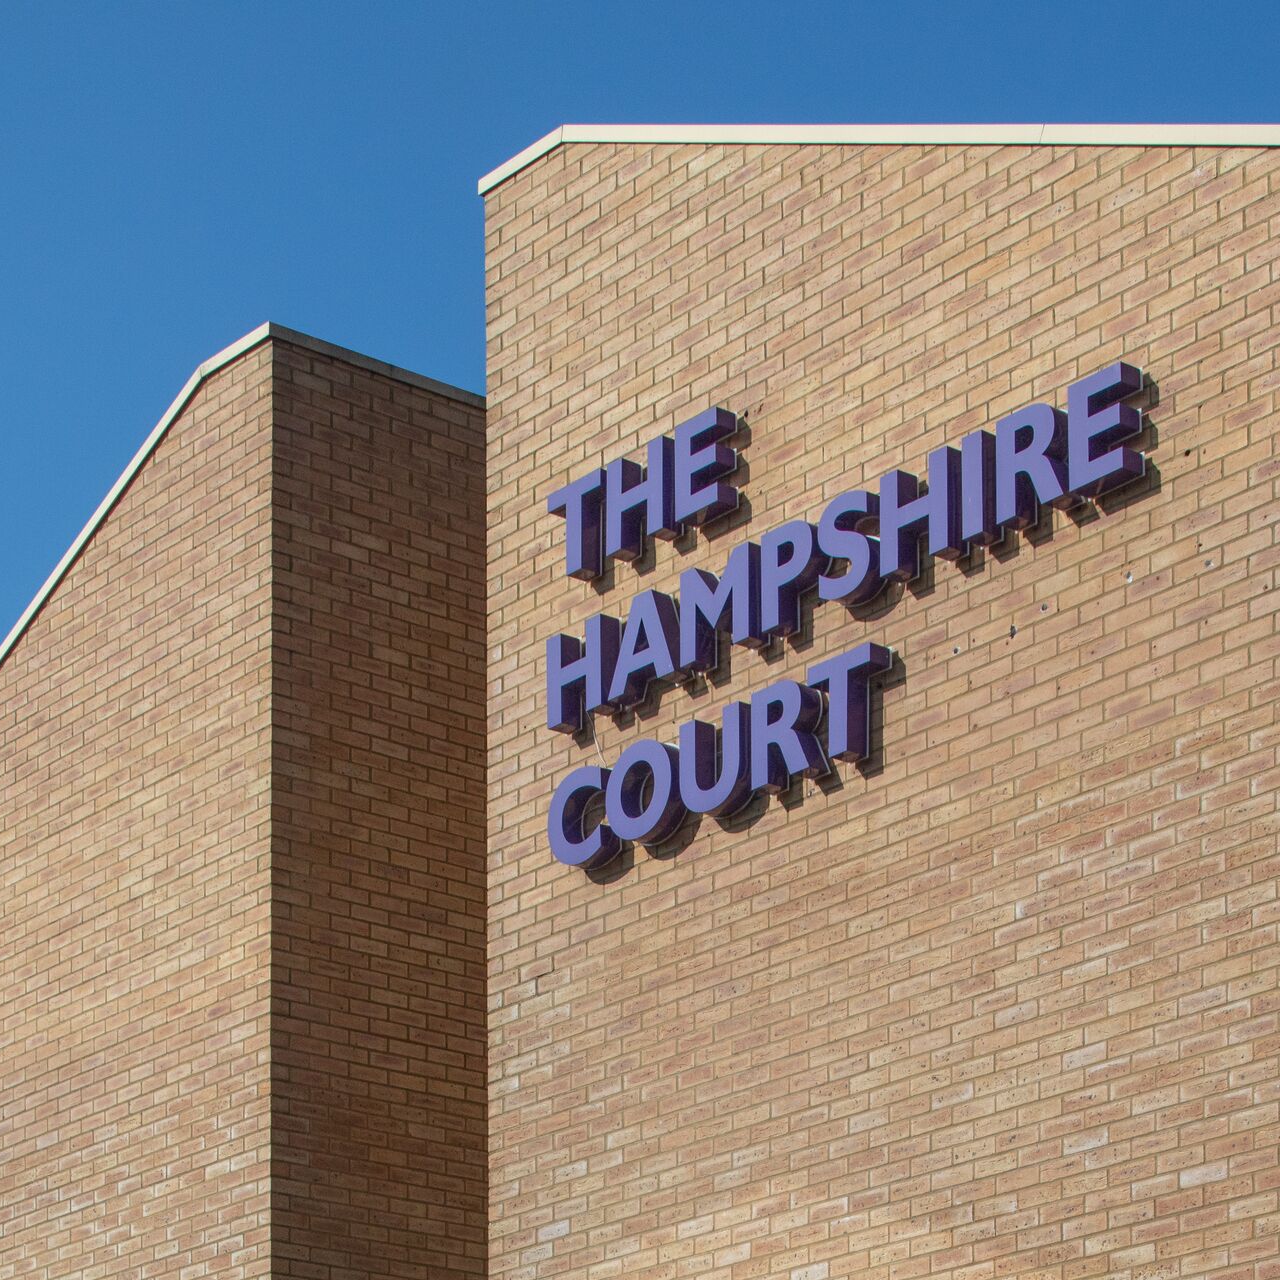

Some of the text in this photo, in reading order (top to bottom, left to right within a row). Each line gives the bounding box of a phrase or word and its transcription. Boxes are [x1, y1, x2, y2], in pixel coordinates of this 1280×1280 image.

[546, 361, 1142, 733] HAMPSHIRE
[547, 406, 736, 581] THE
[547, 642, 890, 868] COURT
